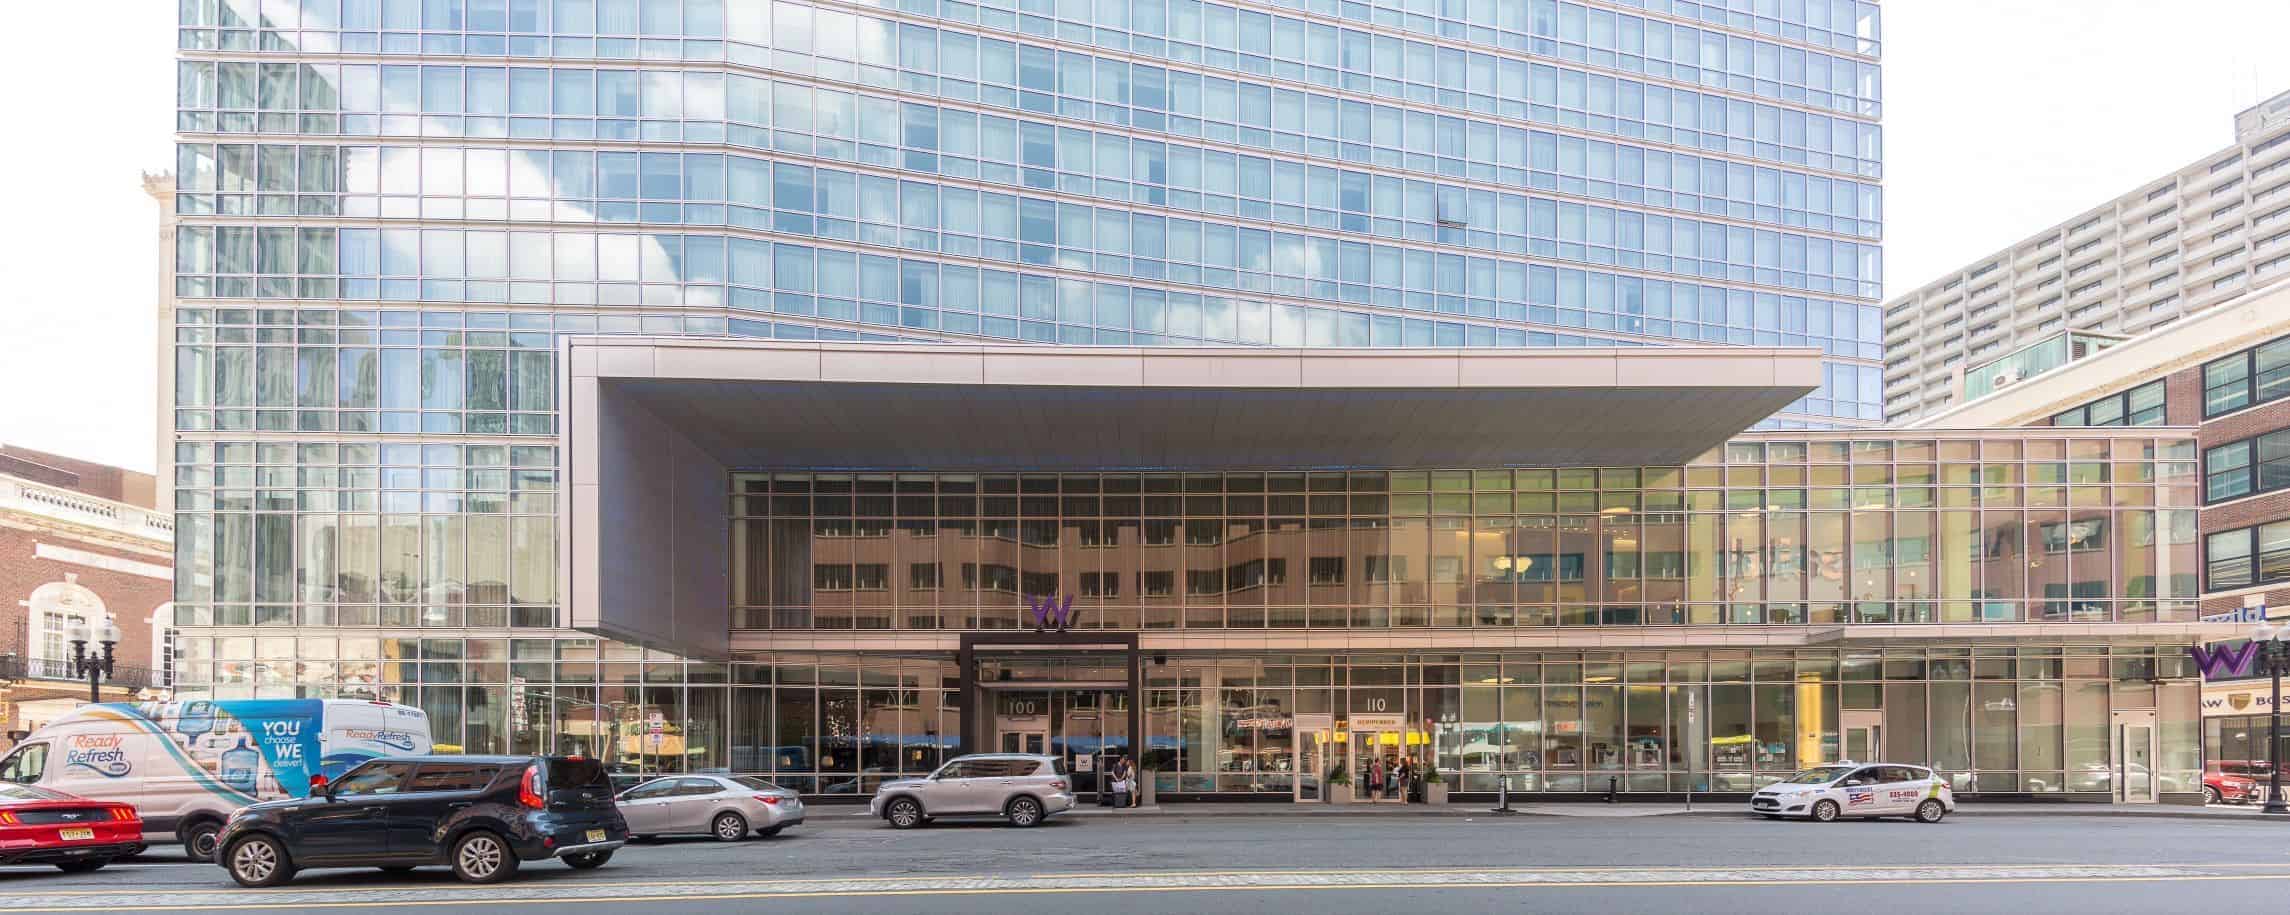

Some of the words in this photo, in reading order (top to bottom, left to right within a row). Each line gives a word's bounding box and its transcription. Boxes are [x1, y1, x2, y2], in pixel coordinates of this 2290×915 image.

[2192, 638, 2259, 679] W
[1009, 701, 1035, 714] 100
[1367, 698, 1386, 712] 110
[262, 720, 300, 736] YOU
[75, 734, 122, 749] Ready
[264, 735, 297, 744] choose
[67, 748, 124, 763] Refresh
[276, 744, 303, 759] WE
